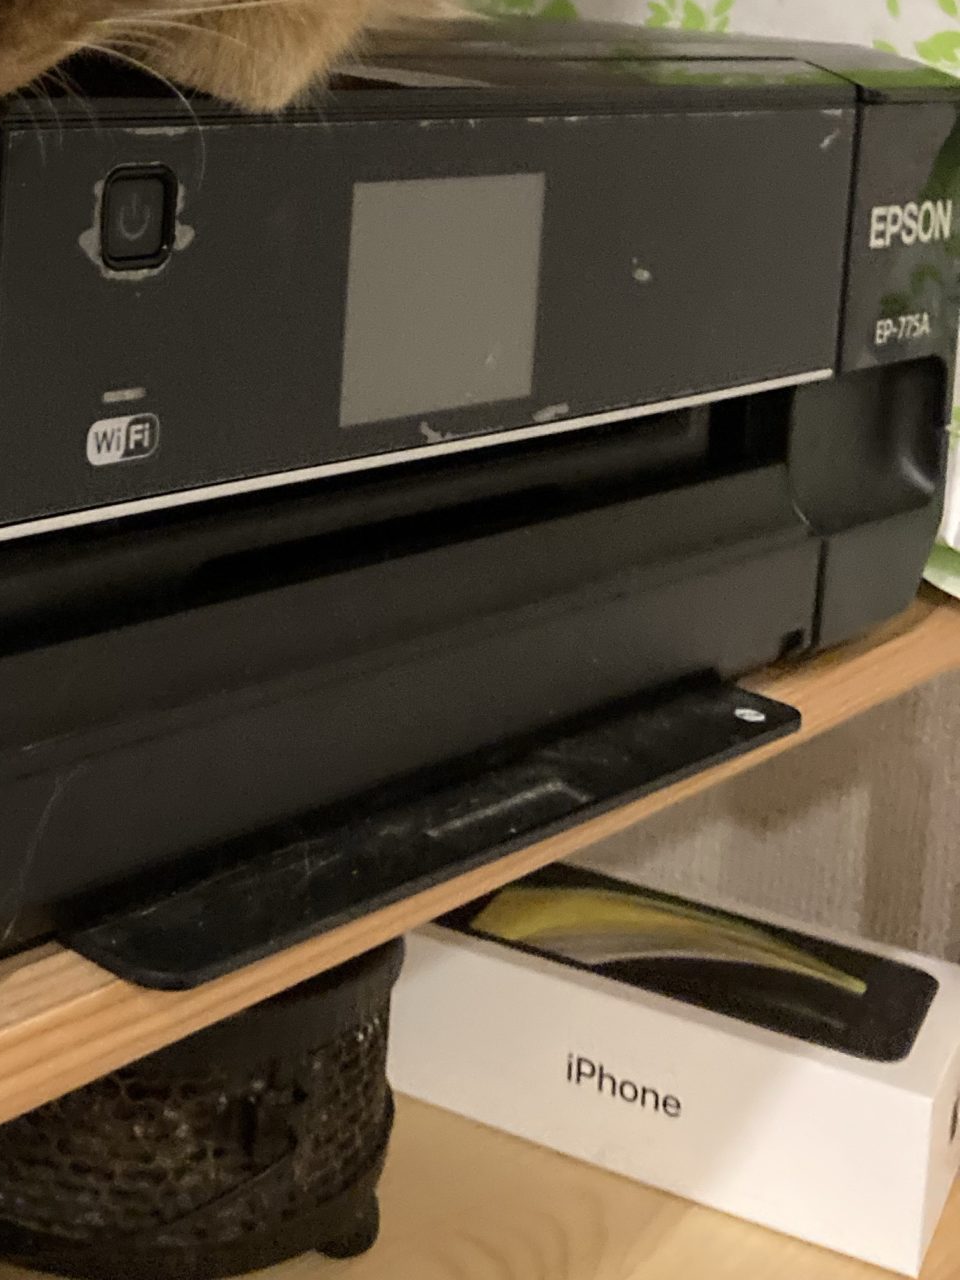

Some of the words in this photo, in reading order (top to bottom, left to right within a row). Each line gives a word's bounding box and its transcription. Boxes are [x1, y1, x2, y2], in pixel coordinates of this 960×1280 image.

[869, 199, 953, 249] EPSON
[874, 312, 930, 345] EP-775A
[566, 1053, 682, 1118] iPhone
